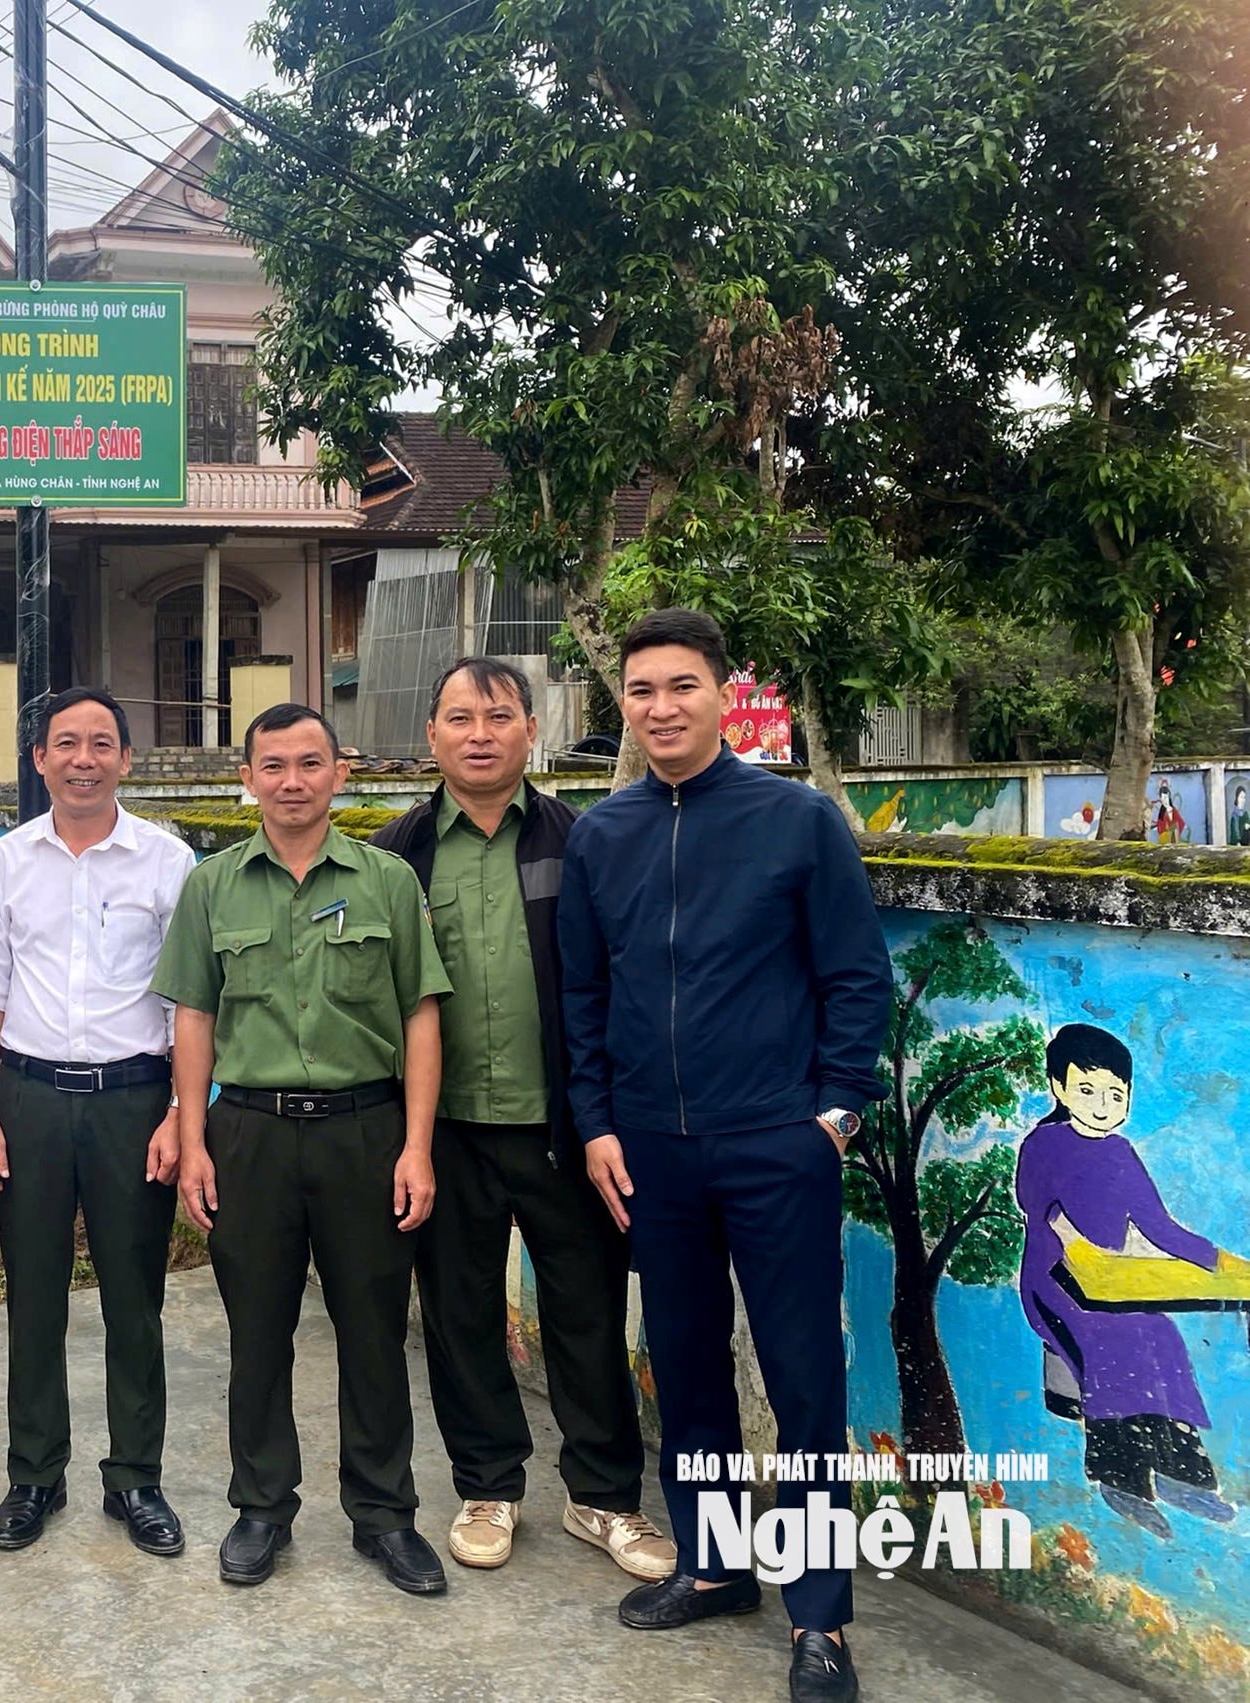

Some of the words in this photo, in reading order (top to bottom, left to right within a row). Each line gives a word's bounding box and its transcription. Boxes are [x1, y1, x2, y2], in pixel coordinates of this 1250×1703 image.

[34, 300, 78, 317] PHÒNG
[82, 301, 99, 321] HỘ
[103, 301, 128, 319] QUỲ
[131, 301, 166, 318] CHÂU
[37, 328, 99, 358] TRÌNH
[6, 364, 29, 402] KẾ
[32, 368, 71, 402] NĂM
[75, 374, 115, 403] 2025
[121, 375, 173, 406] (FRPA)
[12, 419, 50, 467] ĐIỆN
[98, 420, 142, 461] SÁNG
[5, 475, 38, 488] HÙNG
[82, 474, 107, 488] TỈNH
[110, 475, 141, 491] NGHỆ
[143, 478, 160, 488] AN
